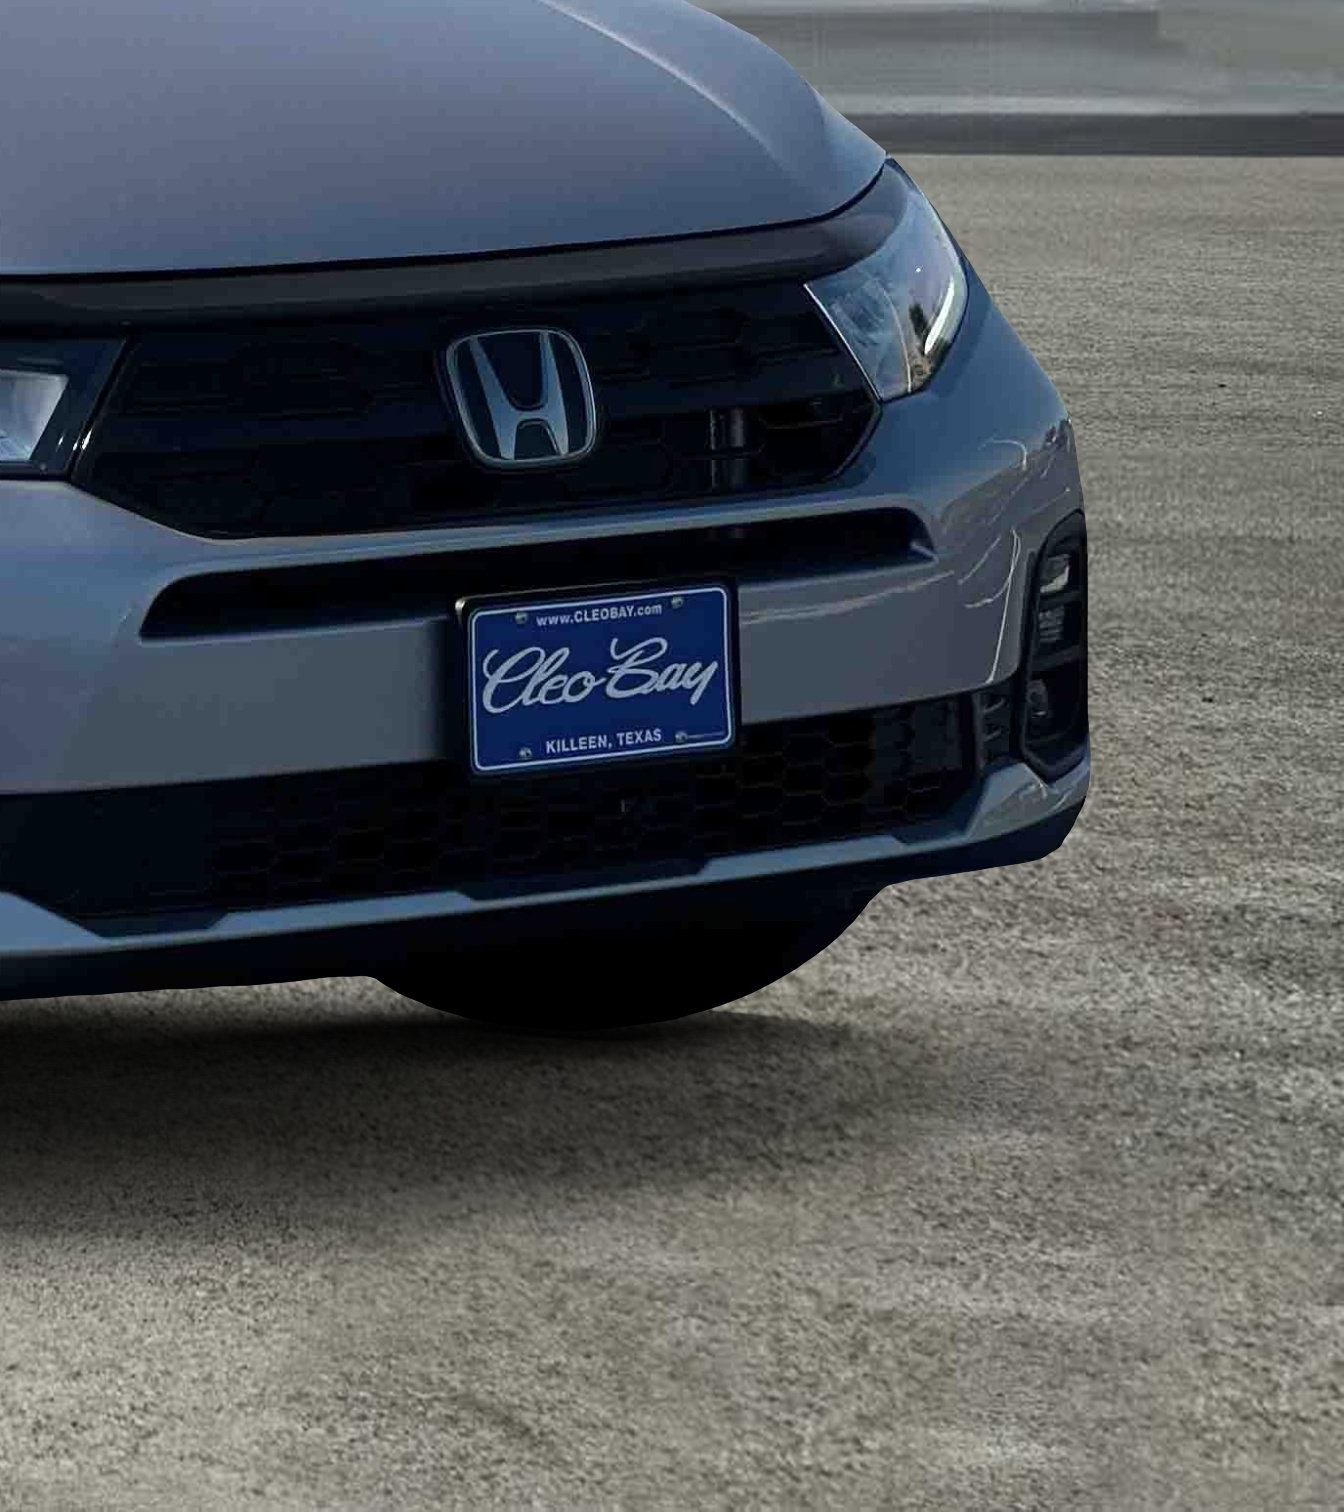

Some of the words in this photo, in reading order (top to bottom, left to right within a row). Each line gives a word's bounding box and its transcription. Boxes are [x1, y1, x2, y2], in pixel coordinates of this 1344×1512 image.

[535, 603, 663, 627] www.CLEOBAY.com
[482, 645, 607, 715] Cleo
[605, 637, 719, 706] Bay
[545, 733, 613, 755] KILLEEN,
[615, 727, 662, 747] TEXAS
